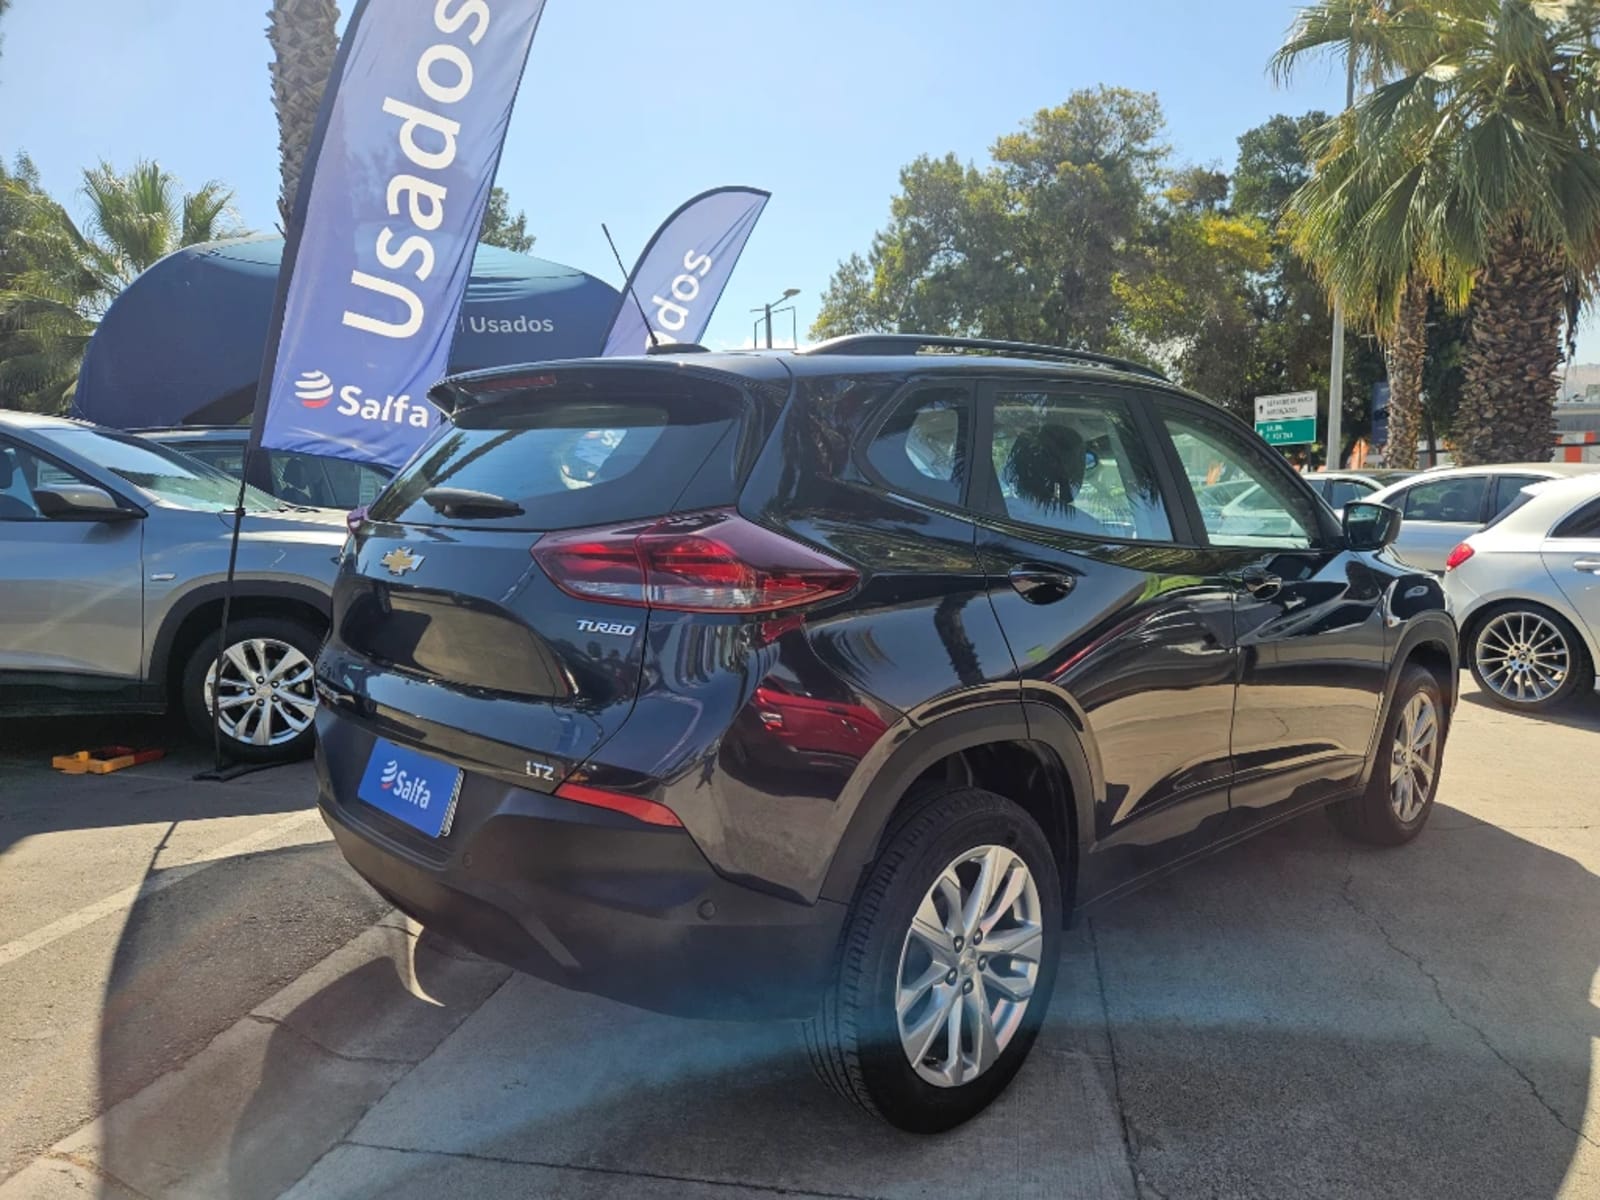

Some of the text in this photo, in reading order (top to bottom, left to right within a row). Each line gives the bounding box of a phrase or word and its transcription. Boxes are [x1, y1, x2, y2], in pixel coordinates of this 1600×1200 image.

[341, 0, 490, 339] Usados
[469, 315, 554, 333] Usados
[337, 383, 429, 428] Salfa
[576, 619, 637, 636] TURBO
[526, 760, 554, 781] LTZ
[393, 770, 431, 810] Salfa
